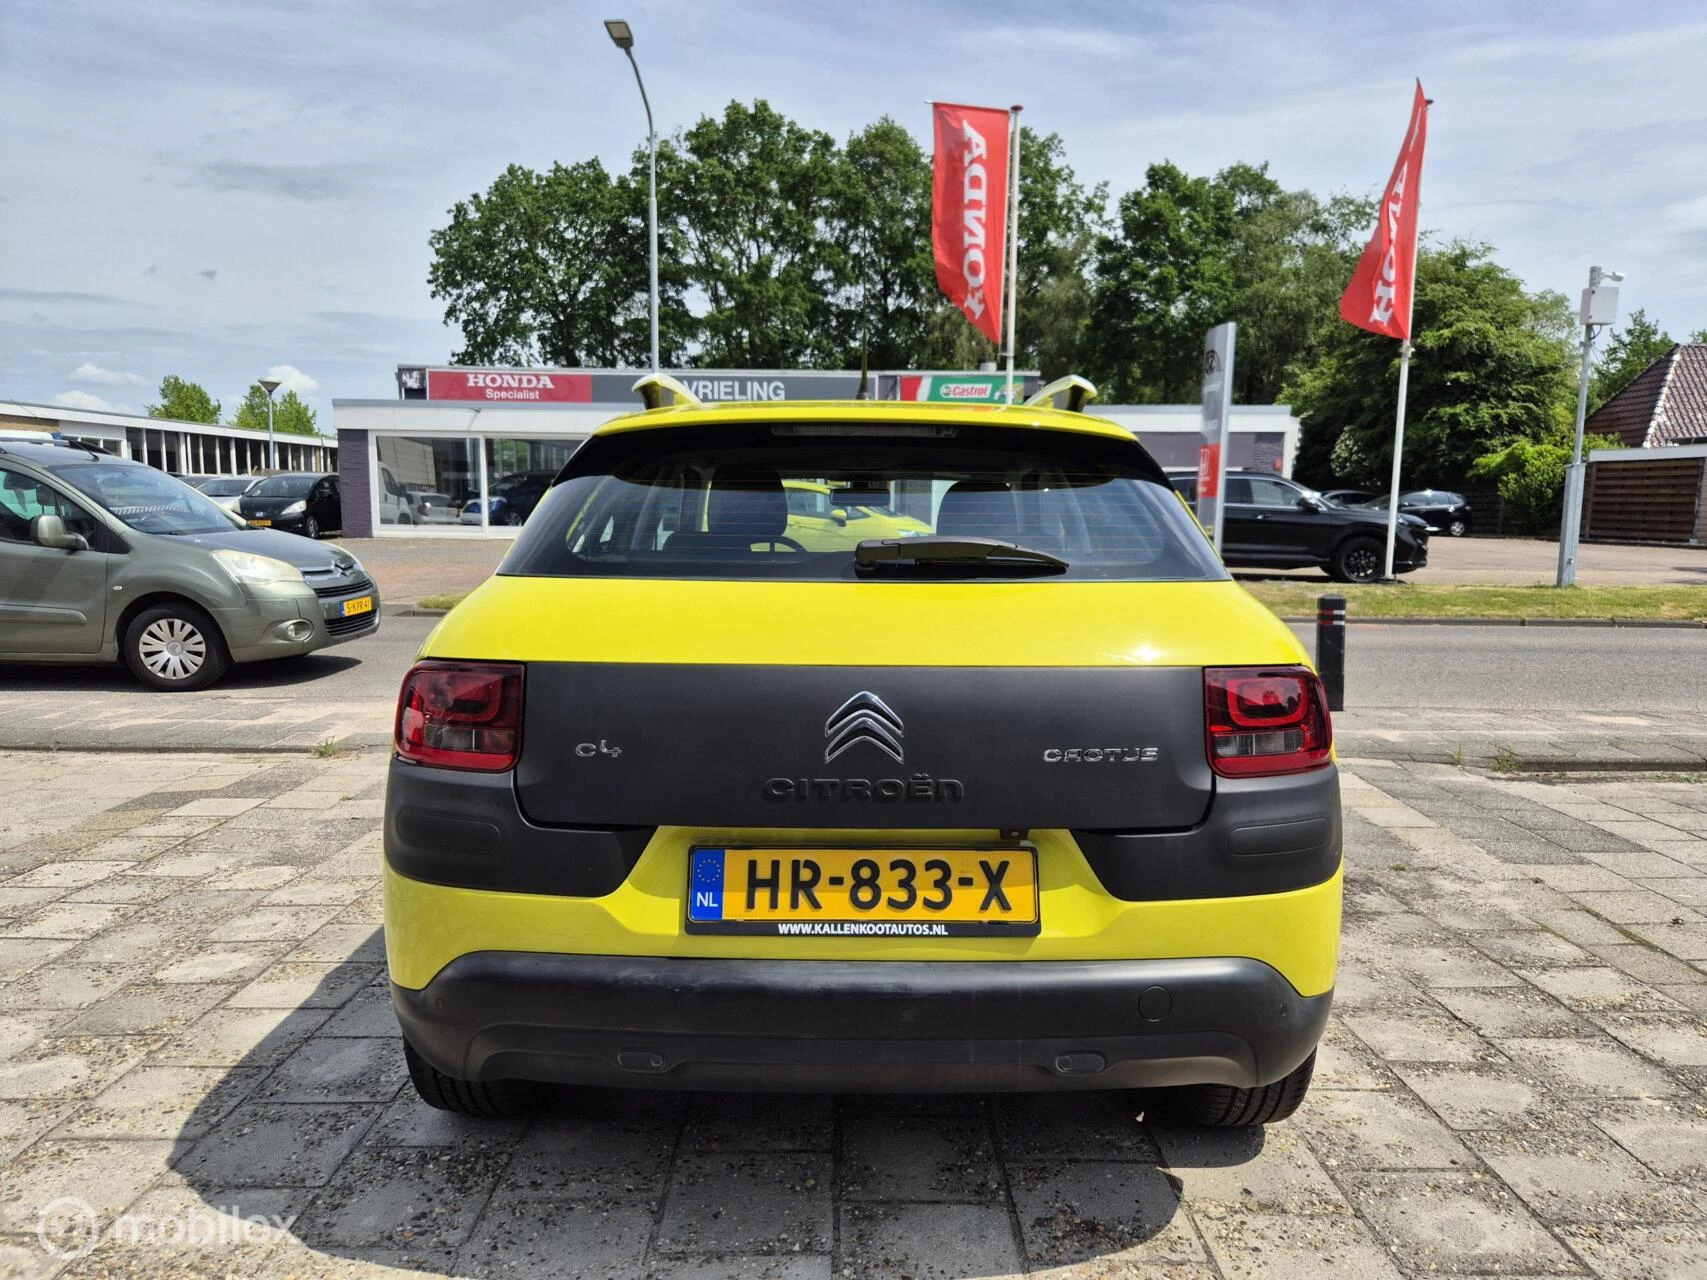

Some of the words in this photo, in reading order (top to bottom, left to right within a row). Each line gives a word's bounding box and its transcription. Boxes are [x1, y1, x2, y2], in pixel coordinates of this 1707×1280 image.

[466, 373, 555, 389] HONDA
[485, 388, 540, 400] Specialist
[682, 380, 786, 401] VRIELING
[952, 385, 990, 397] Castrol
[575, 739, 623, 757] C4
[1042, 747, 1158, 762] CACTUS
[763, 773, 966, 803] CITROËN
[745, 858, 1013, 912] HR-833-X
[696, 891, 719, 908] NL
[777, 923, 949, 936] WWW.KALLENKOOTAUTOS.NL
